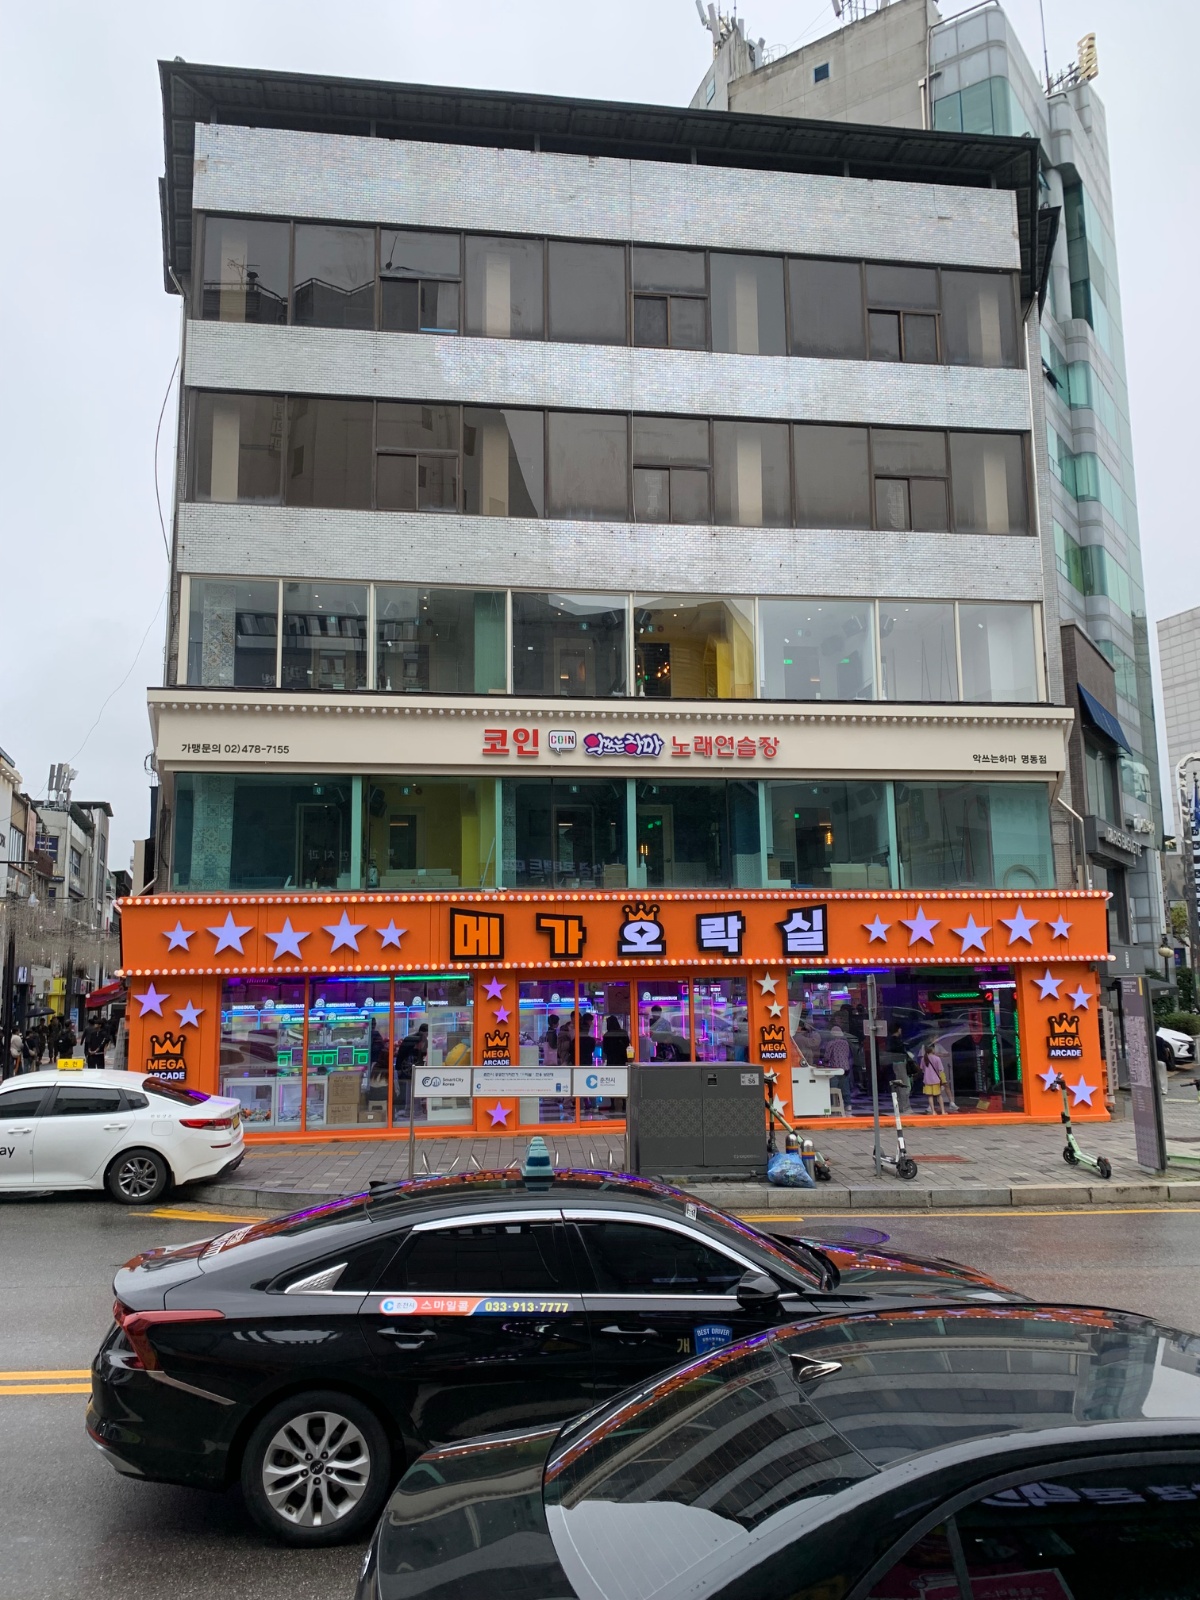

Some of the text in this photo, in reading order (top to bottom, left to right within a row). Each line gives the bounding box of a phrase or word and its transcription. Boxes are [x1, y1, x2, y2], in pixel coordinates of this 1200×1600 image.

[482, 728, 780, 759] 코인 COIN 악쓰는하마 노래연습장
[181, 744, 290, 754] 가맹문의 02)478-7155
[972, 754, 1047, 764] 악쓰는하마 명동점
[761, 1043, 786, 1051] MEGA
[1049, 1037, 1081, 1047] MEGA
[483, 1050, 510, 1058] MEGA
[1050, 1049, 1082, 1057] ARCADE
[147, 1059, 186, 1070] MEGA
[420, 1300, 469, 1312] 스마일콜
[697, 1327, 730, 1337] BEST DRIVER
[676, 1337, 691, 1353] 개
